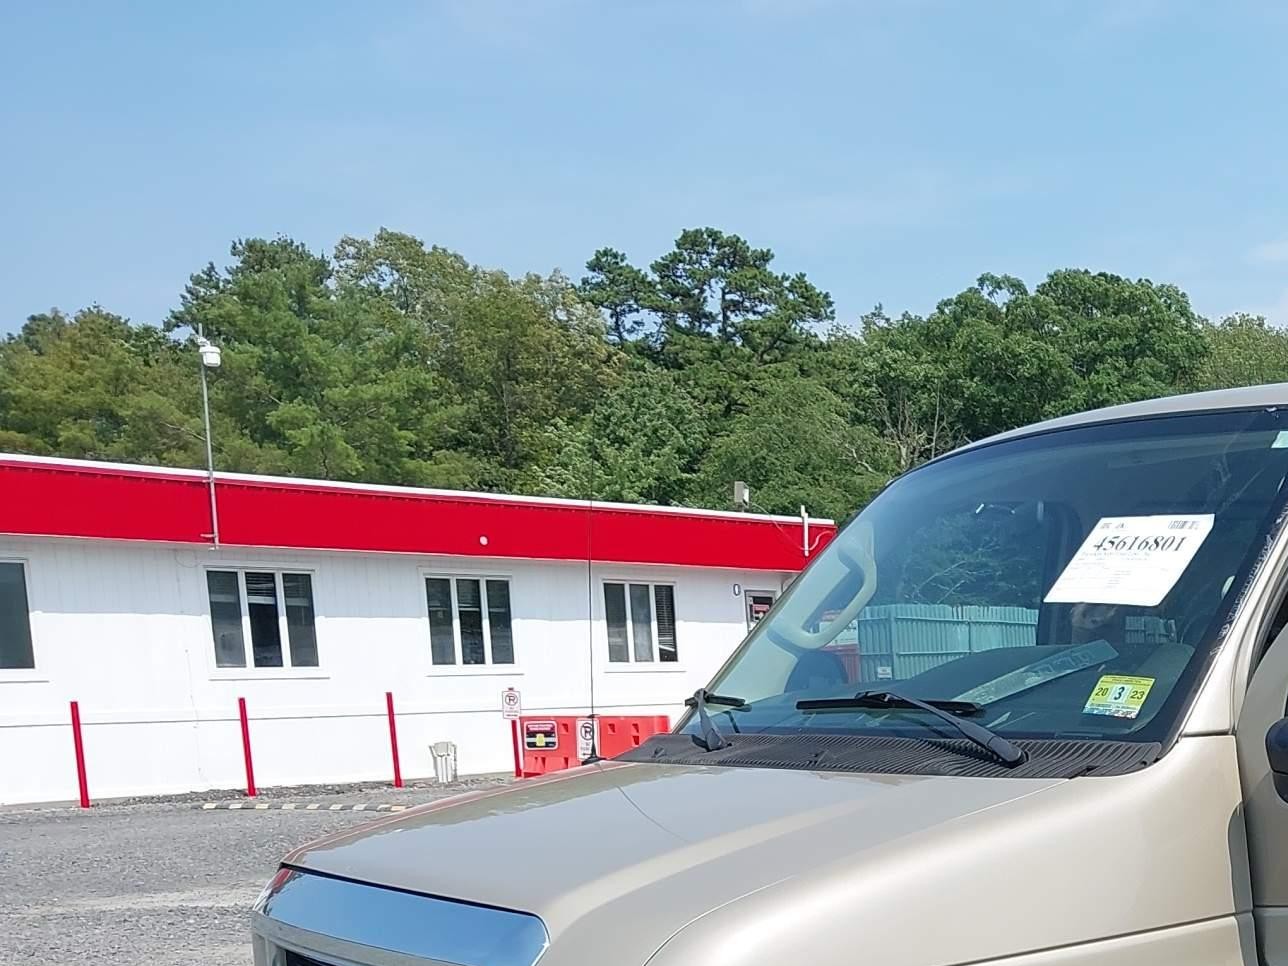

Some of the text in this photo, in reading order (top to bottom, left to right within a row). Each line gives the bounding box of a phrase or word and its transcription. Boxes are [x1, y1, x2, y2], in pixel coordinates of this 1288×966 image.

[1093, 535, 1188, 552] 45616801
[1095, 686, 1145, 700] 20 3 23
